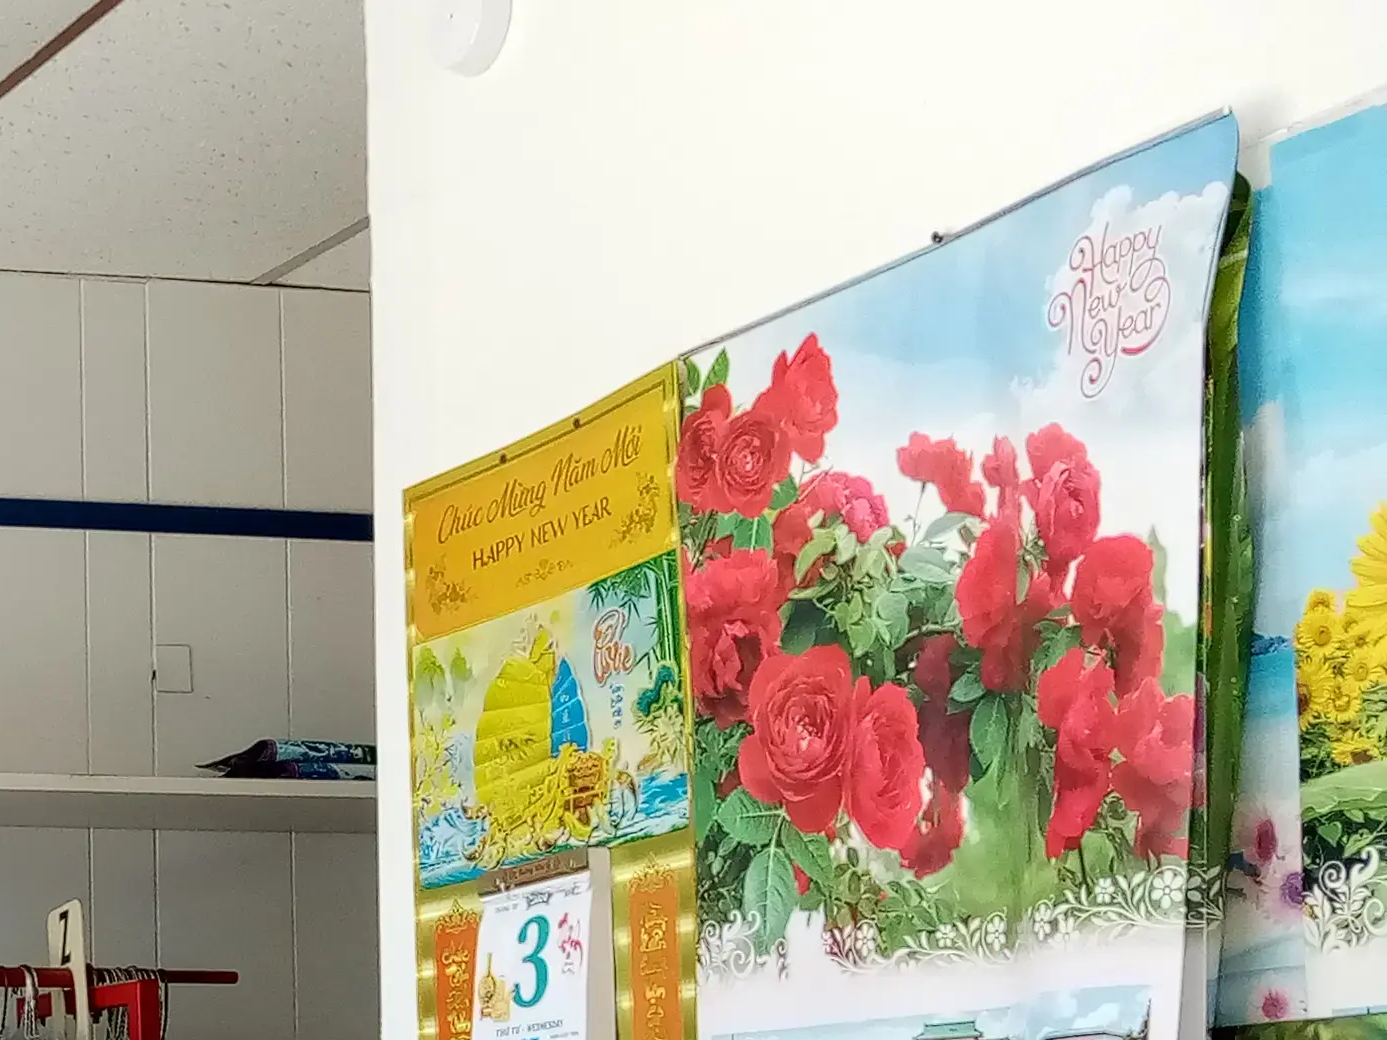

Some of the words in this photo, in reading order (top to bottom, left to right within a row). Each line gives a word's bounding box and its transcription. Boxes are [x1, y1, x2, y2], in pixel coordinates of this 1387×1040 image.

[1070, 221, 1165, 298] Happy
[1048, 279, 1128, 355] New
[1080, 276, 1171, 399] Year
[438, 503, 483, 544] Chúc
[551, 453, 595, 496] Năm
[472, 533, 525, 570] HAPPY
[530, 515, 568, 548] NEW
[572, 496, 612, 531] YEAR
[513, 914, 550, 1008] 3
